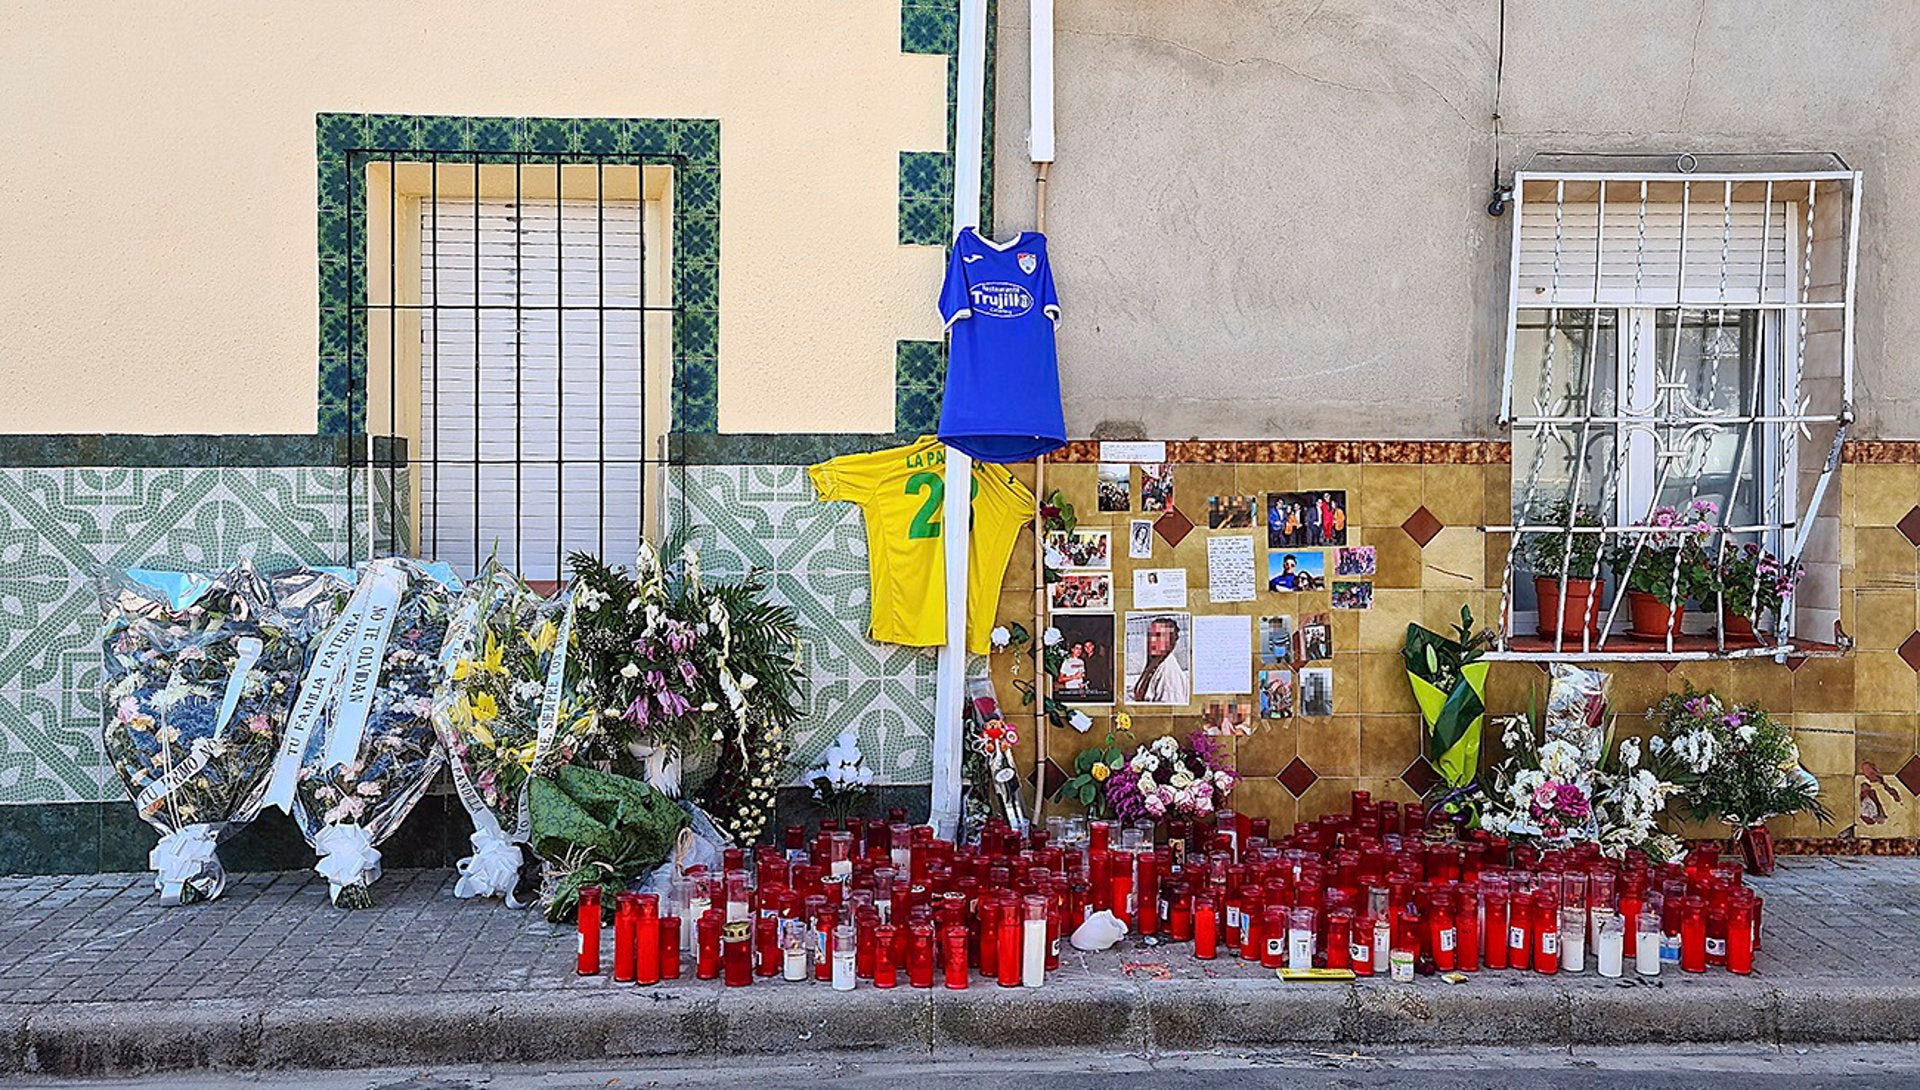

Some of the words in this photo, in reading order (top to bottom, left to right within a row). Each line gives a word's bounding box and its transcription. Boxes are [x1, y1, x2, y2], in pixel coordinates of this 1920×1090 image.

[905, 453, 924, 468] LA
[370, 606, 387, 621] NO
[363, 626, 381, 641] TE
[350, 647, 375, 703] OLVIDAN
[550, 653, 563, 676] CON
[287, 737, 300, 755] TU
[294, 677, 327, 731] FAMILIA
[320, 612, 361, 669] PATERNA
[542, 680, 560, 729] SIEMPRE
[139, 786, 158, 805] TU
[453, 767, 485, 815] PANDILLA
